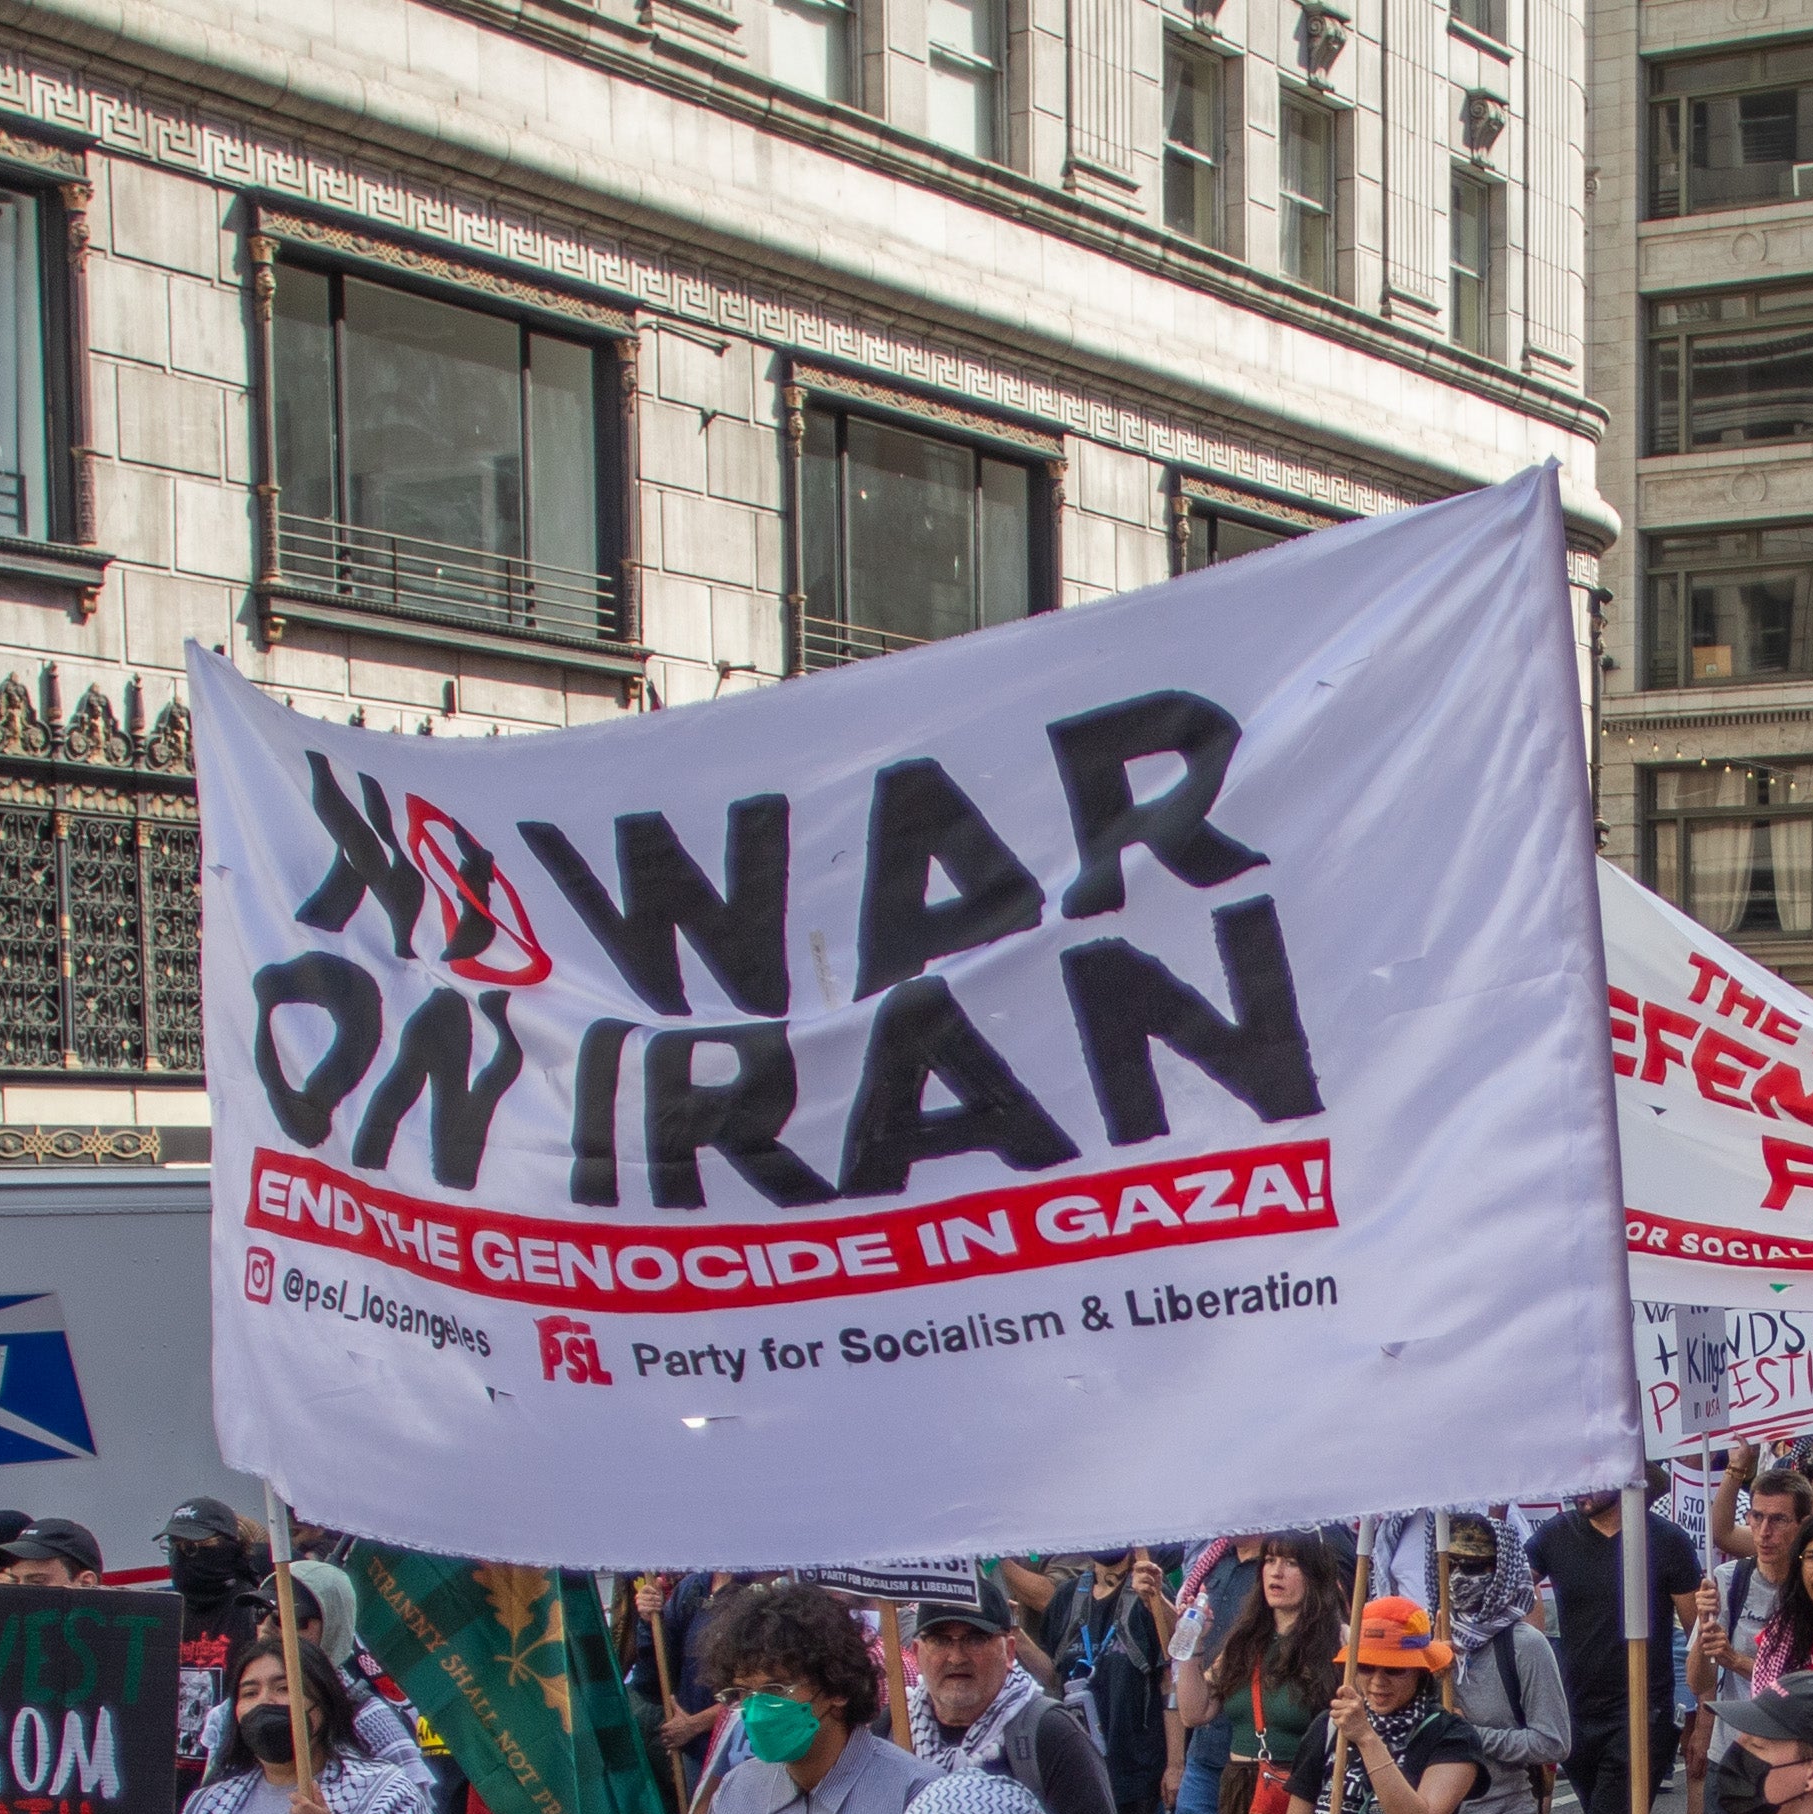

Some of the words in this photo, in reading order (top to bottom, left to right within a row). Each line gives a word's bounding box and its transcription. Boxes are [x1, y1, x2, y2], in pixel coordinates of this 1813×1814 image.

[516, 688, 1272, 1018] WAR
[252, 950, 523, 1192] ON
[568, 893, 1327, 1210] IRAN
[1686, 952, 1803, 1046] THE
[258, 1168, 365, 1237] END
[365, 1206, 461, 1272] THE
[470, 1229, 900, 1293] GENOCIDE
[916, 1210, 1019, 1267] IN
[1036, 1159, 1325, 1246] GAZA!
[283, 1266, 492, 1358] @psl_losangeles
[539, 1327, 612, 1386] PSL
[632, 1341, 747, 1384] Party
[762, 1339, 824, 1374] for
[838, 1306, 1064, 1365] Socialism
[1080, 1294, 1114, 1333] &
[1128, 1271, 1338, 1328] Liberation
[1687, 1331, 1726, 1393] Kings
[821, 1570, 847, 1584] PARTY
[848, 1575, 861, 1586] FOR
[862, 1577, 909, 1591] SOCIALISM
[921, 1581, 973, 1596] LIBERATION
[367, 1556, 448, 1653] TYRANNY
[440, 1654, 498, 1729] SHALL
[495, 1729, 540, 1787] NOT
